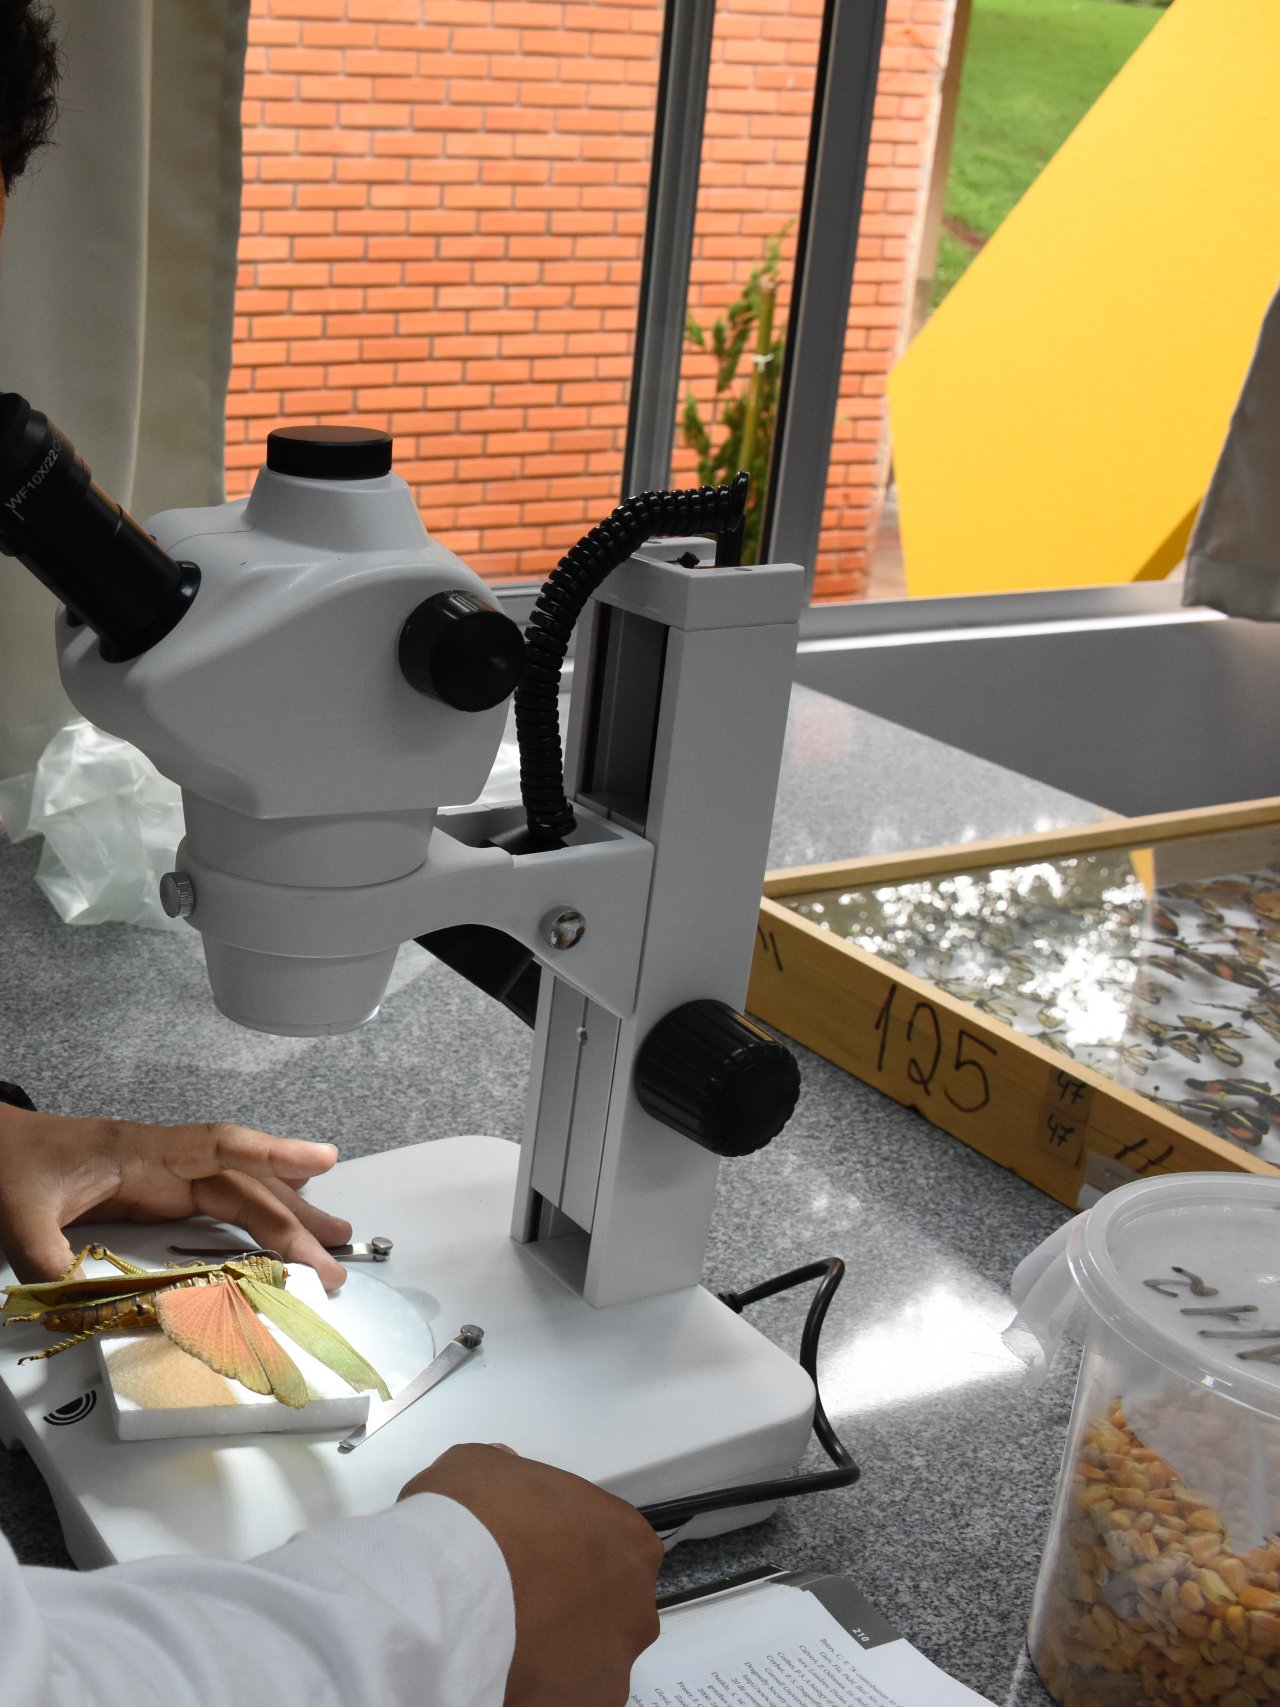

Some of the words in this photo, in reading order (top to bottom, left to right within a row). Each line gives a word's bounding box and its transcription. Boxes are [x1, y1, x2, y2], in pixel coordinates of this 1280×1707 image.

[875, 984, 997, 1113] 125
[1057, 1071, 1087, 1104] 47
[1047, 1113, 1075, 1147] 47
[852, 1627, 870, 1642] 210
